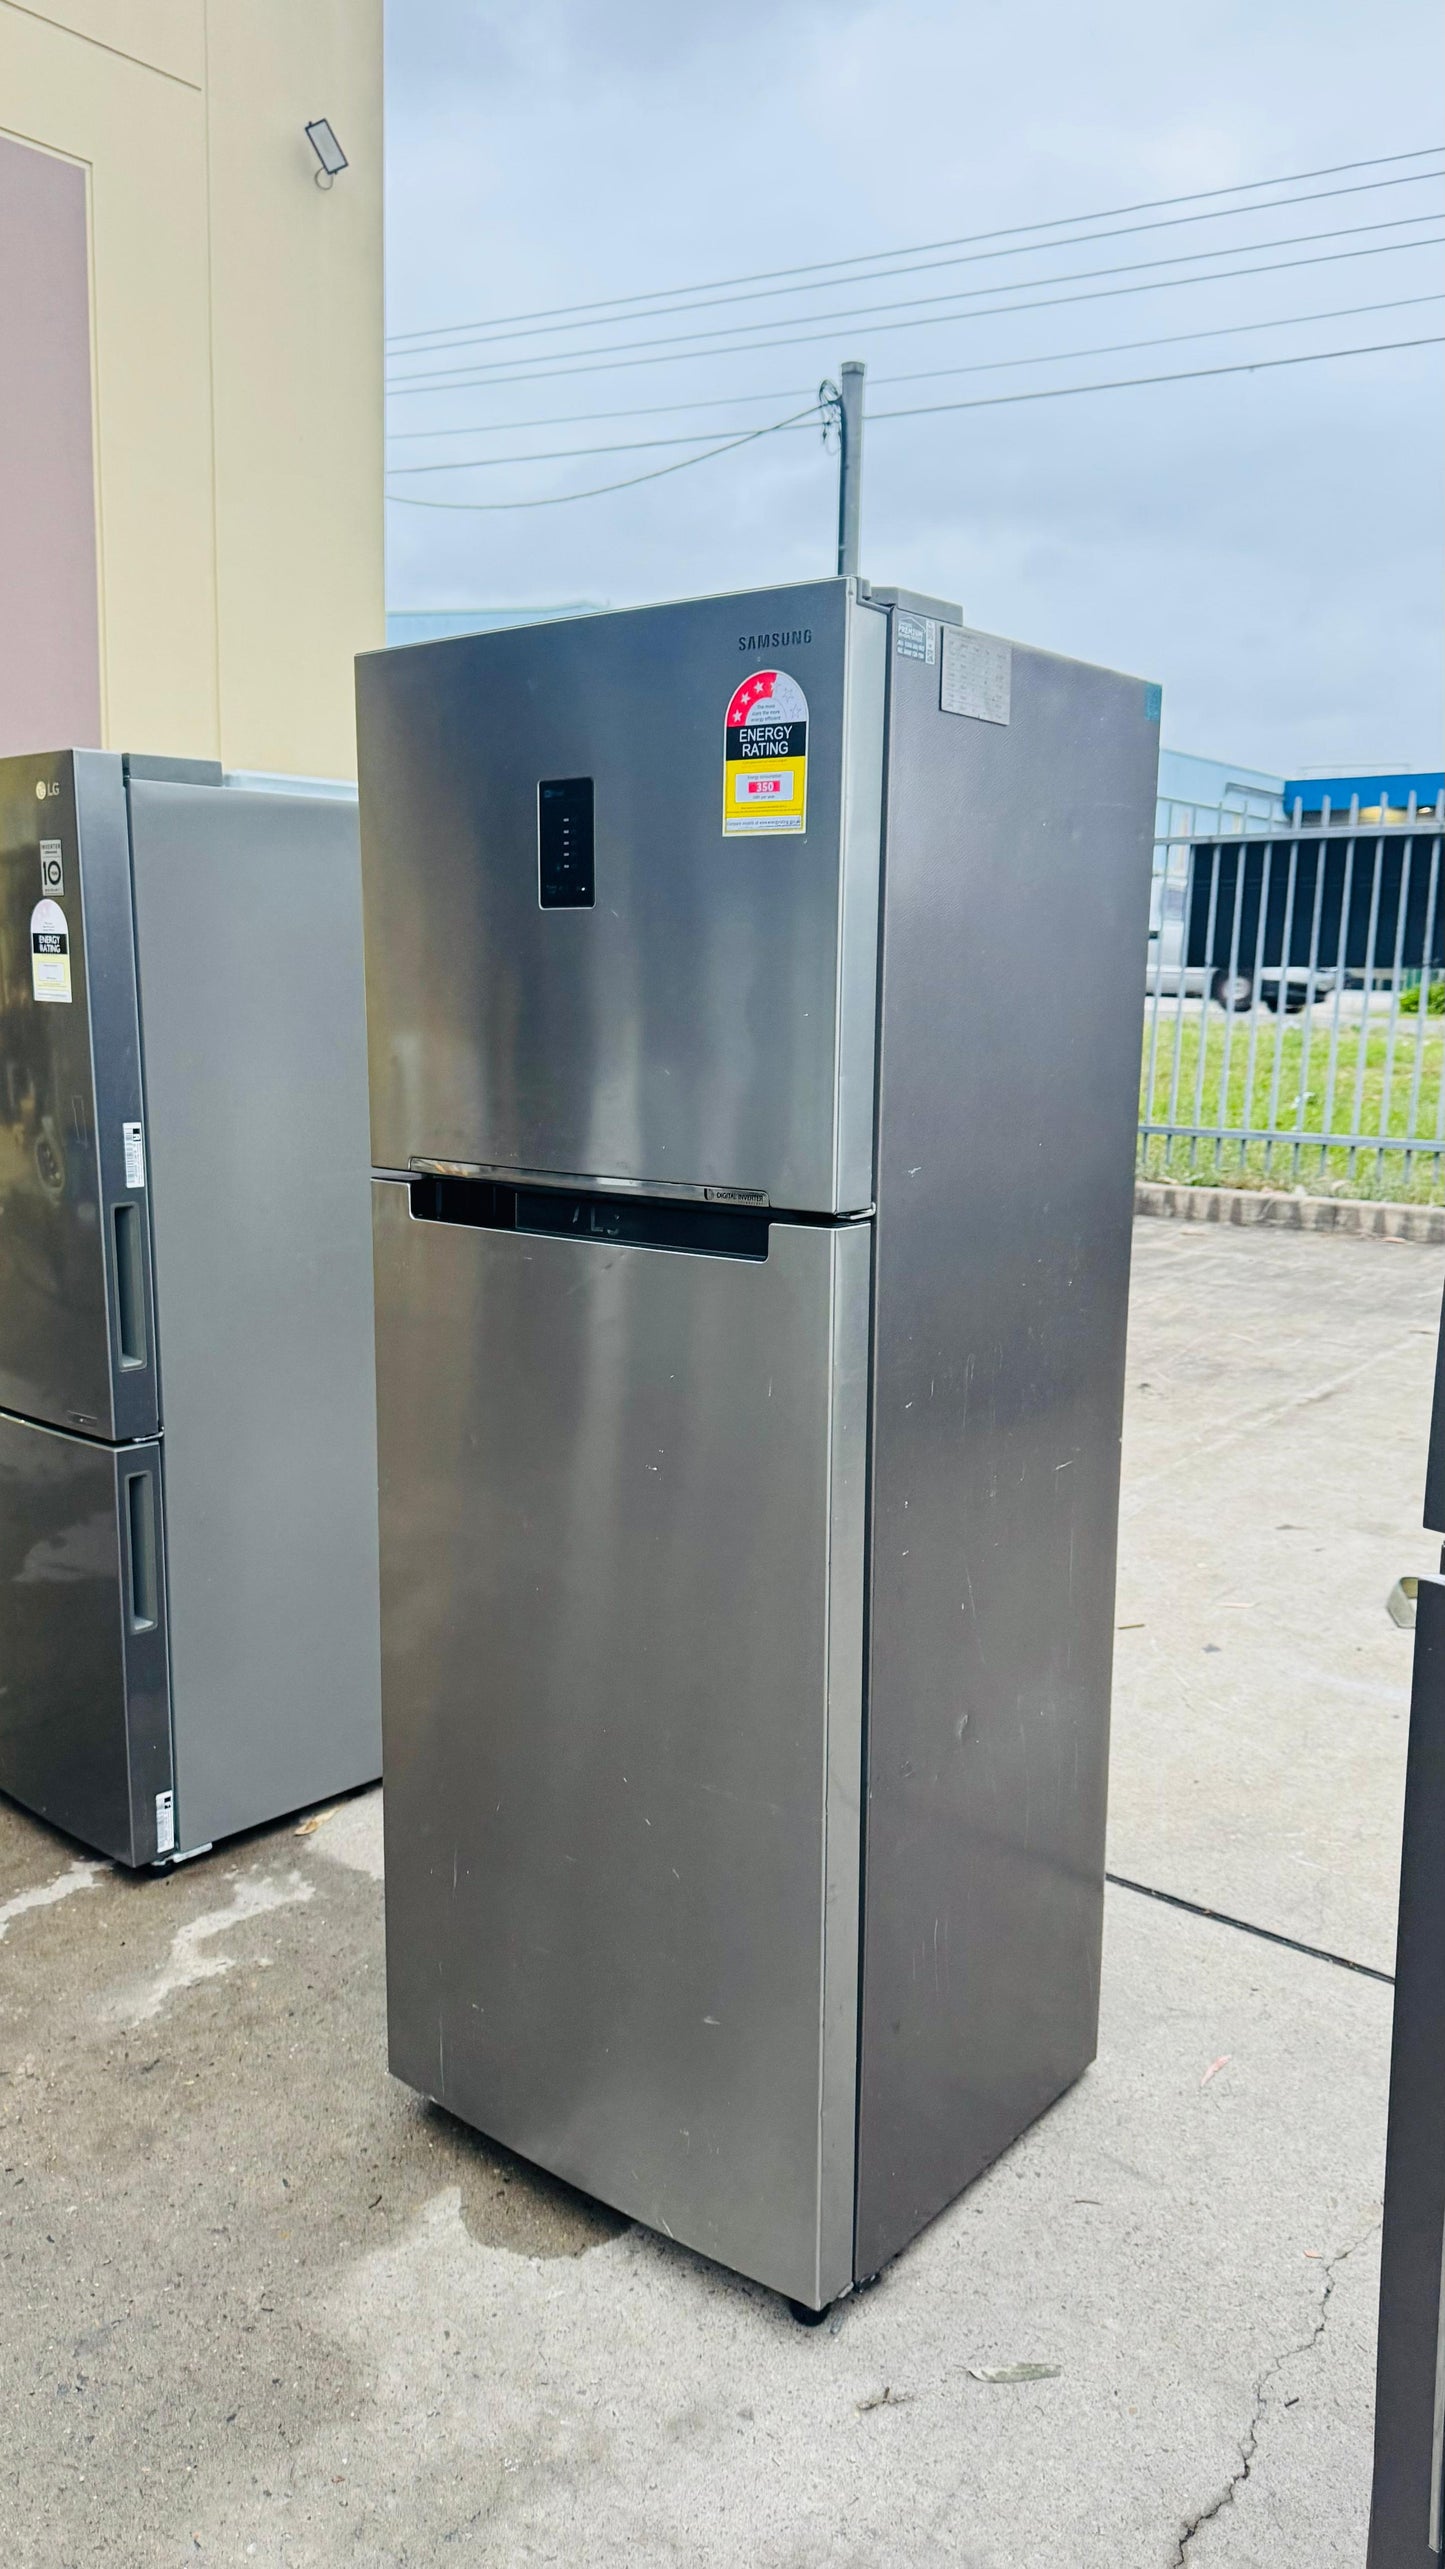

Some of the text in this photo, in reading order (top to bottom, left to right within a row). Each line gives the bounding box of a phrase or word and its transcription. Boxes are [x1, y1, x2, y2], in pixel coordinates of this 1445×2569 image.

[739, 629, 812, 651] SAMSUNG
[739, 725, 793, 743] ENERGY
[742, 741, 789, 757] RATING
[47, 782, 60, 796] LG
[756, 781, 774, 792] 350
[43, 860, 61, 886] 10
[38, 934, 61, 944] ENERGY
[39, 944, 61, 953] RATING
[716, 1191, 764, 1202] DIGITAL INVERTER
